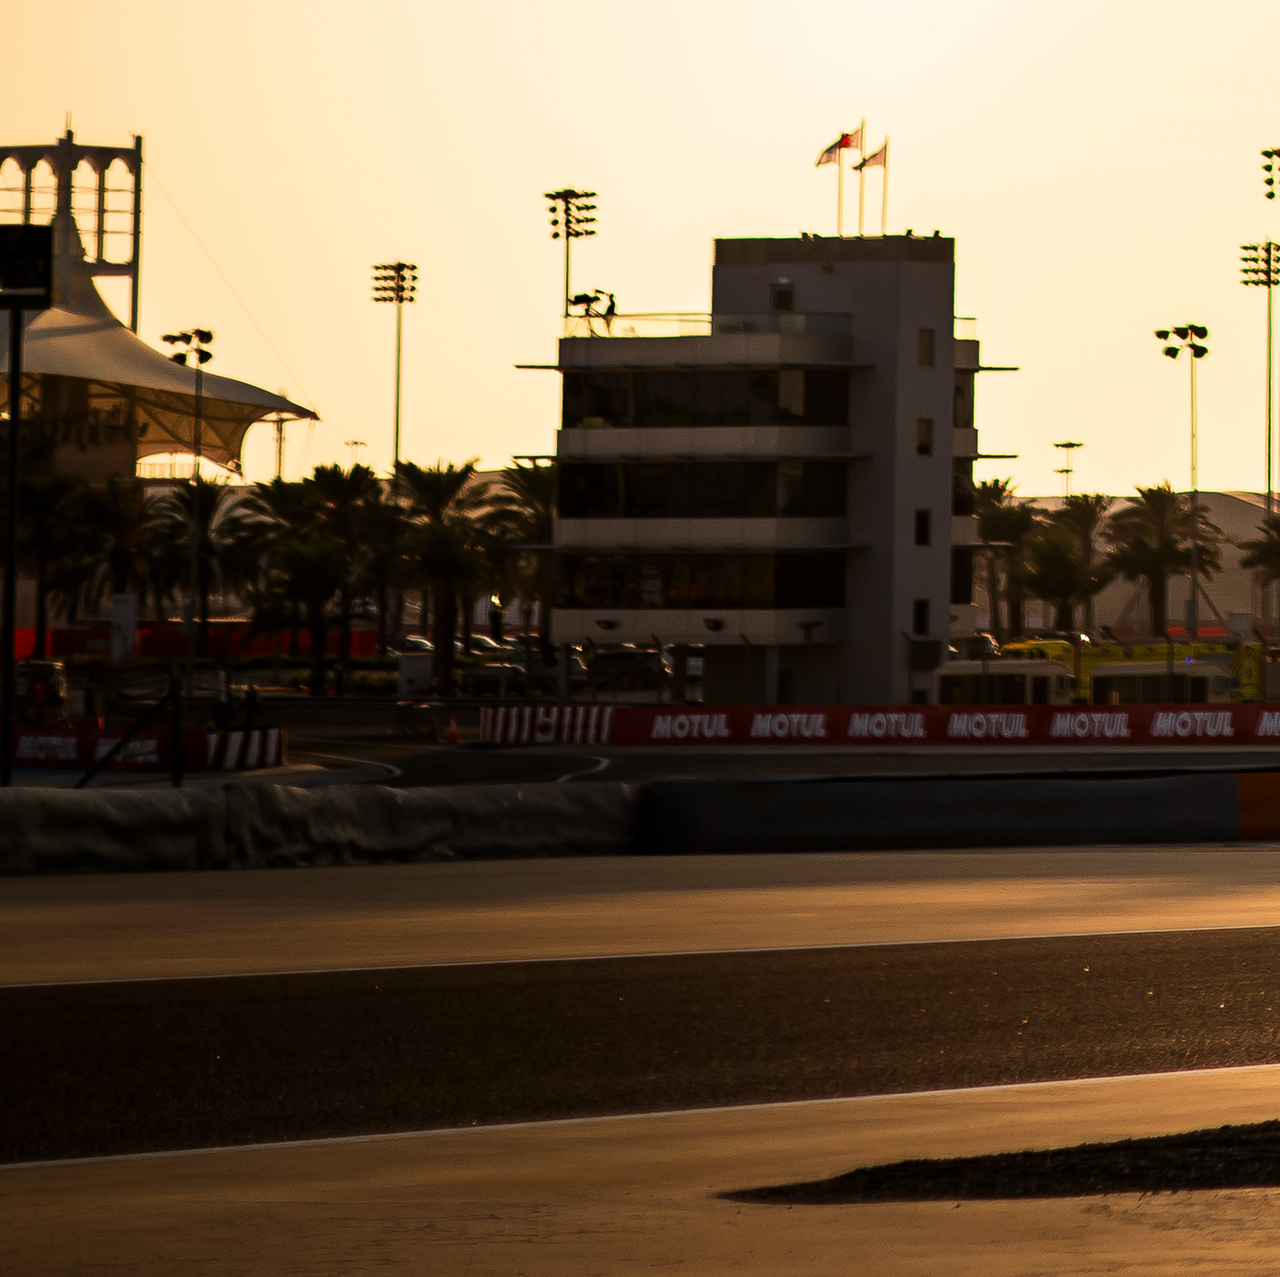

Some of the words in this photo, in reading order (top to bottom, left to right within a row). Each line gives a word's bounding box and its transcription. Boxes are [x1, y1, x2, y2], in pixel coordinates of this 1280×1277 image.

[650, 714, 732, 739] MOTUL
[749, 713, 829, 738] MOTUL
[847, 713, 928, 738] MOTUL
[946, 713, 1030, 738] MOTUL
[1150, 711, 1235, 737] MOTUL
